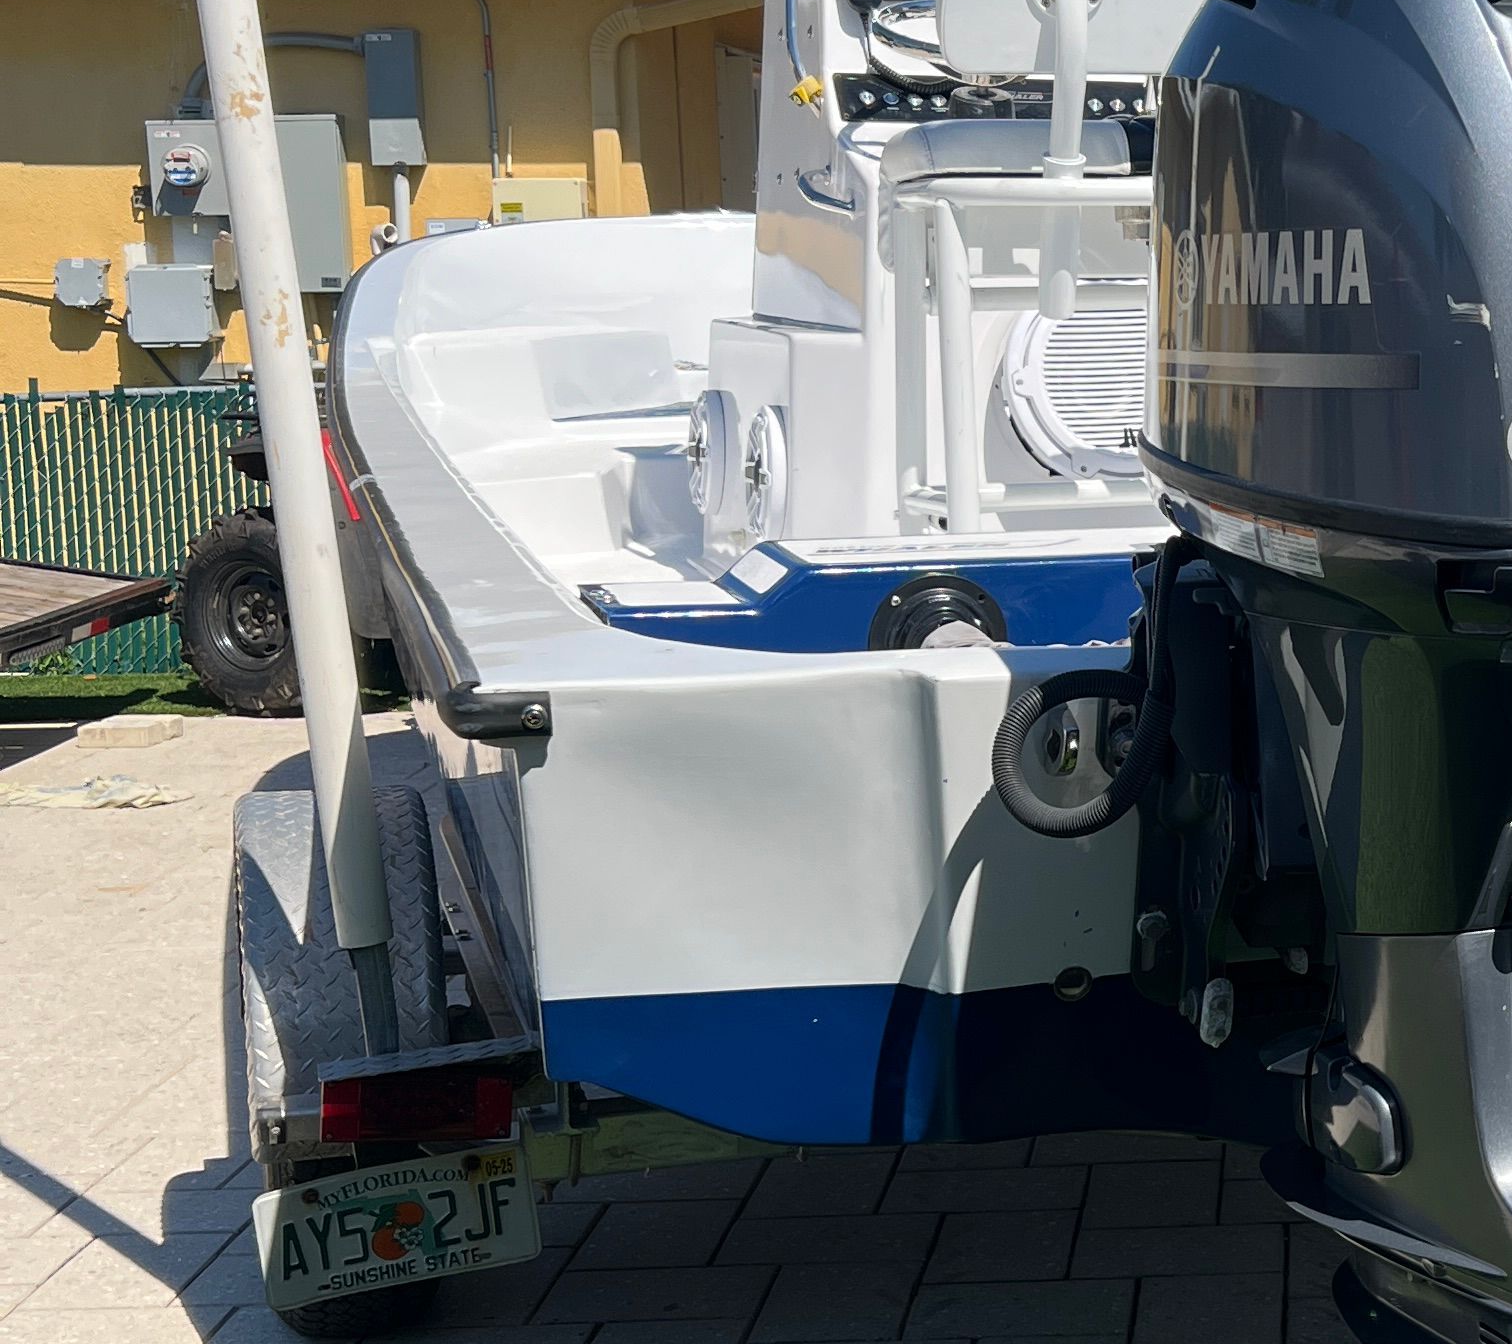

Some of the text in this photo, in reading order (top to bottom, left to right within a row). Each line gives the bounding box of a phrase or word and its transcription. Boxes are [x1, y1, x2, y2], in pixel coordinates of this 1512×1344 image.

[1201, 228, 1372, 305] YAMAHA
[486, 1156, 513, 1177] 05-25
[318, 1167, 469, 1210] MYFLORIDA.COM
[282, 1177, 516, 1281] AY5 2JF
[330, 1247, 482, 1290] SUNSHINE STATE
